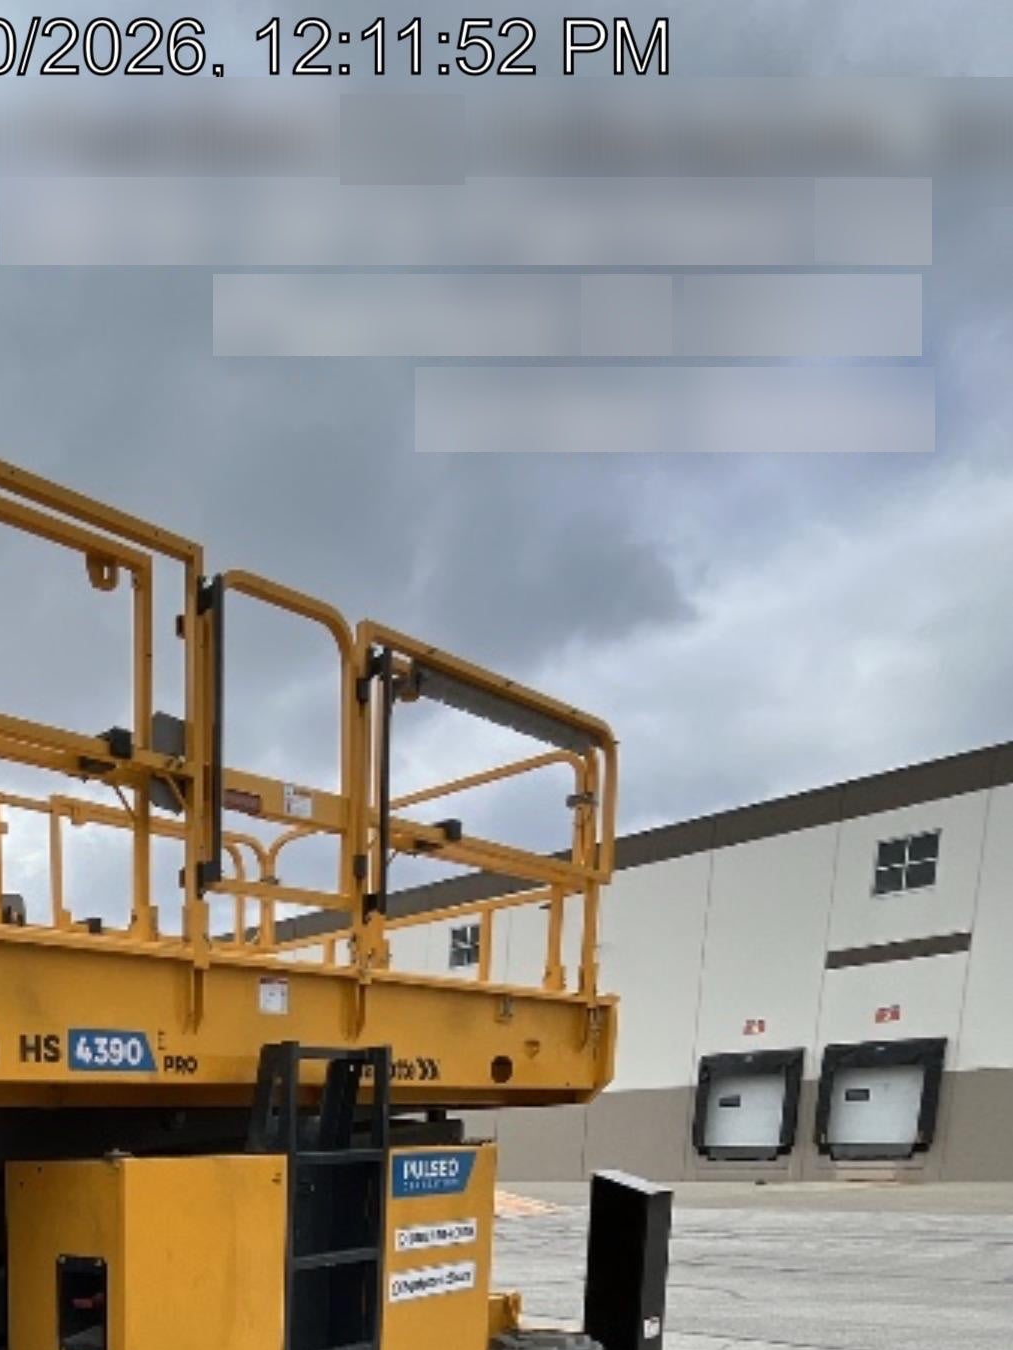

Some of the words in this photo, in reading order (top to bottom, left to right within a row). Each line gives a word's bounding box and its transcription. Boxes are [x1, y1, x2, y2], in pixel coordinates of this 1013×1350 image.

[19, 1034, 61, 1063] HS
[75, 1036, 145, 1067] 4390
[163, 1055, 198, 1074] PRO
